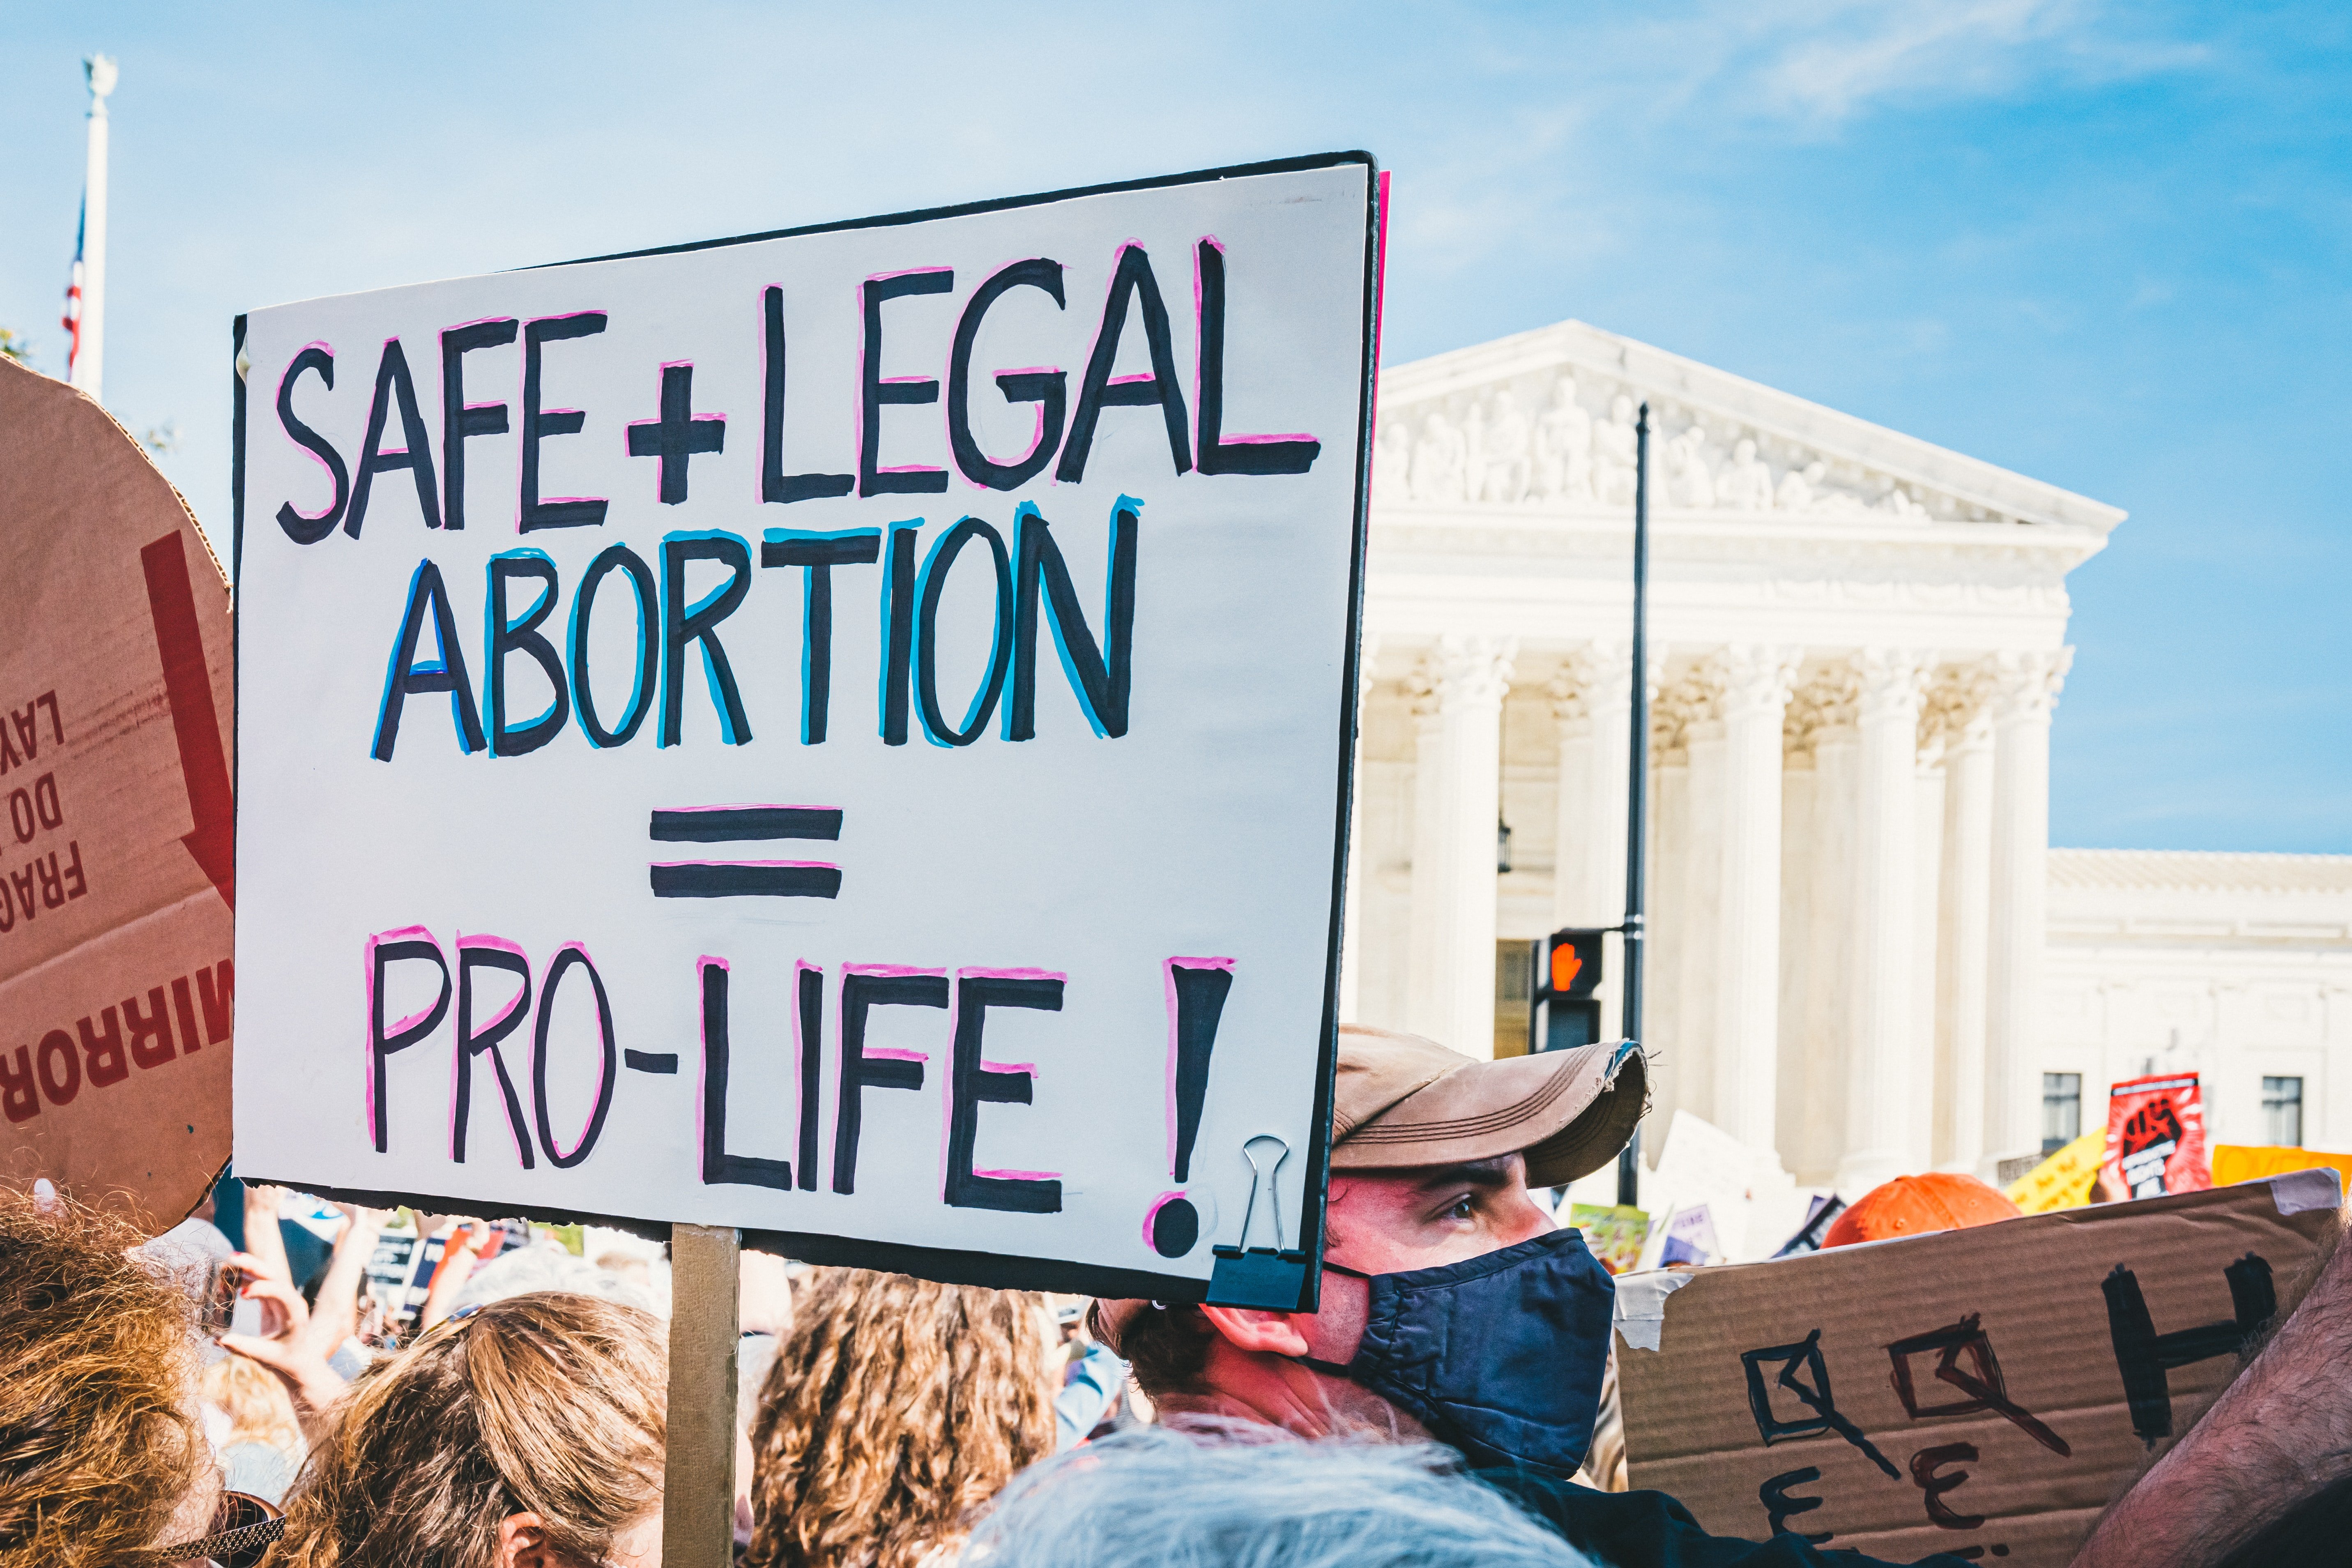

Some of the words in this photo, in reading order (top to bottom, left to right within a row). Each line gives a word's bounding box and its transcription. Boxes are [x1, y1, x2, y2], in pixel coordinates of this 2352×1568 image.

[275, 310, 609, 545] SAFE
[755, 234, 1321, 504] LEGAL
[371, 494, 1144, 762] ABORTION
[9, 771, 63, 843] DO
